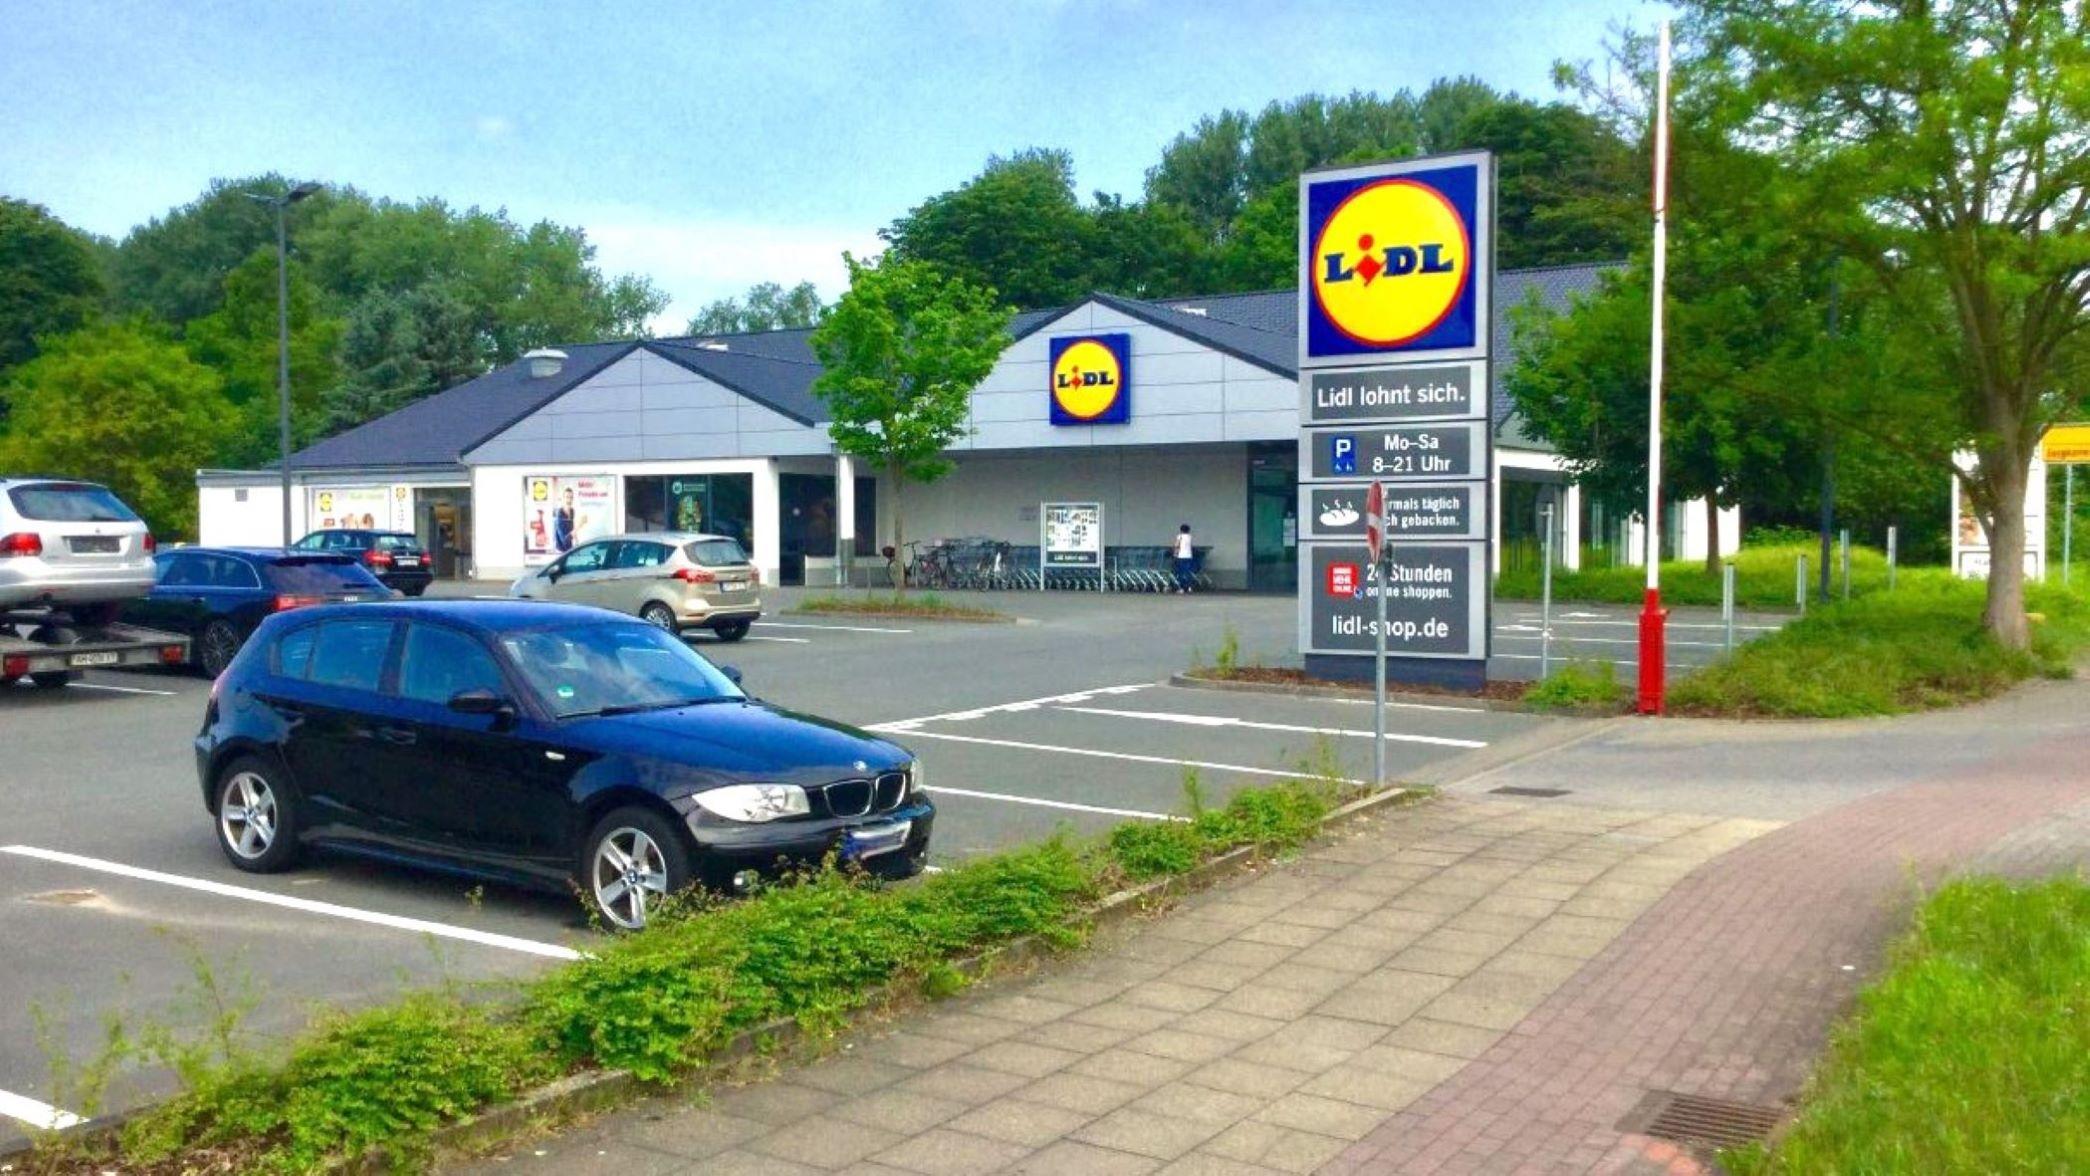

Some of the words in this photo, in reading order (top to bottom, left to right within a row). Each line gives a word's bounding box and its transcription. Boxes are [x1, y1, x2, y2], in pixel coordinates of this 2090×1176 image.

[1324, 234, 1454, 287] LiDL
[1317, 387, 1353, 408] Lidl
[1360, 385, 1411, 406] lohnt
[1417, 383, 1466, 404] sich.
[1336, 439, 1351, 458] P
[1421, 456, 1451, 472] Uhr
[1421, 496, 1460, 513] täglich
[1401, 513, 1460, 529] gebacken.
[1390, 563, 1453, 582] Stunden
[1366, 586, 1399, 597] onne
[1403, 584, 1453, 600] shoppen.
